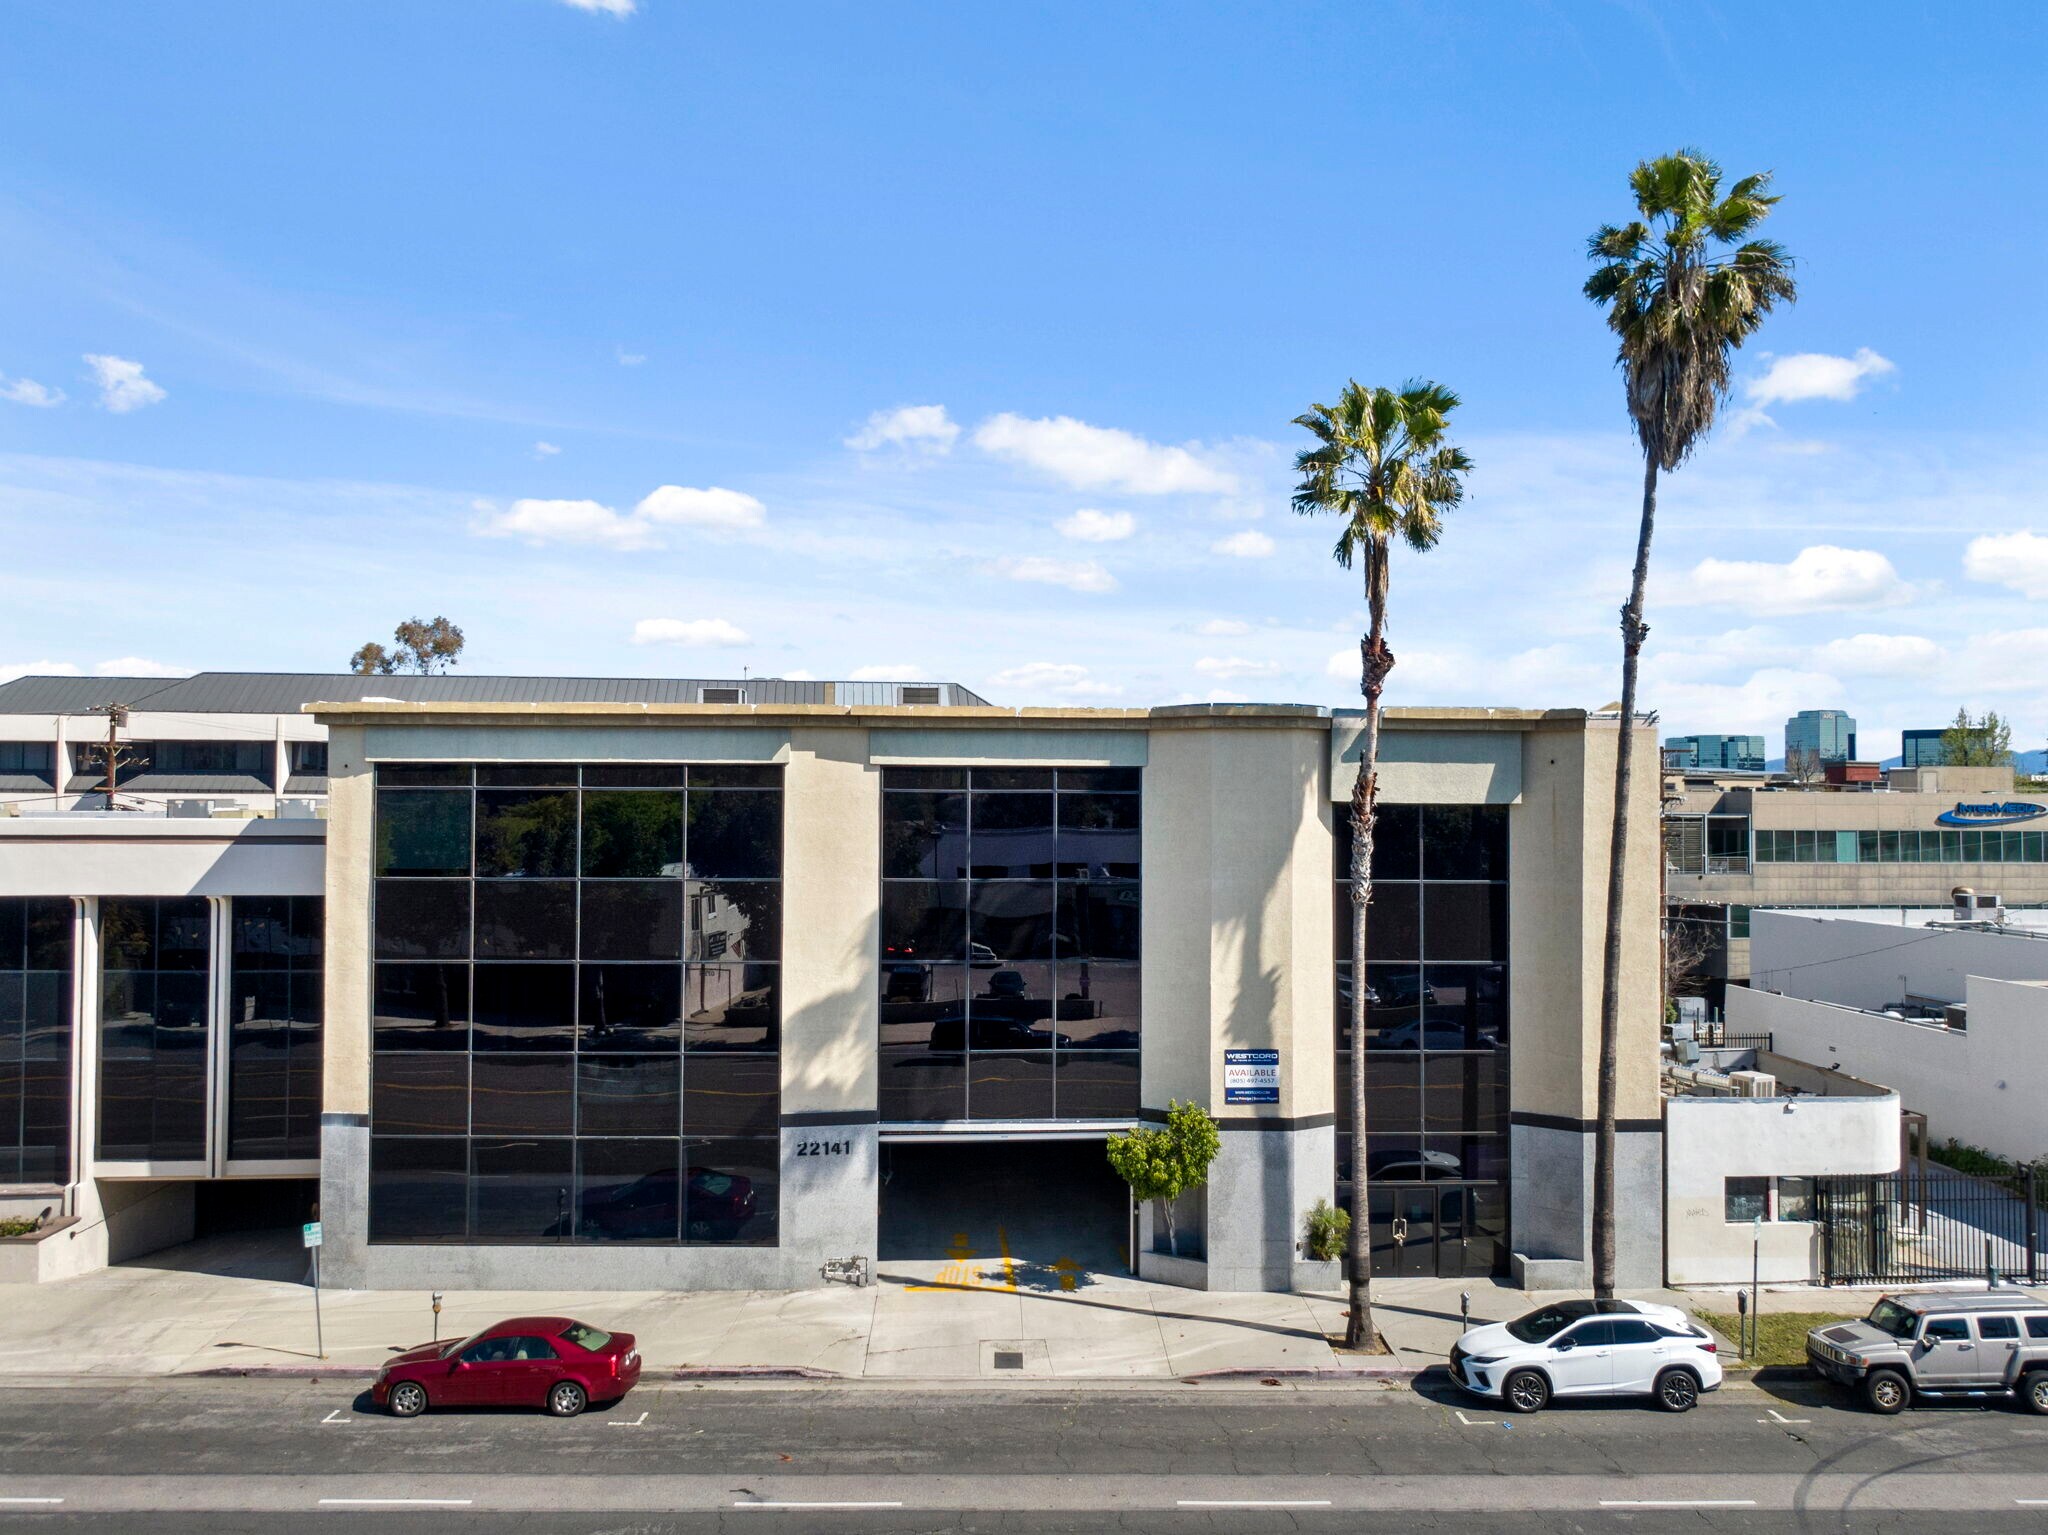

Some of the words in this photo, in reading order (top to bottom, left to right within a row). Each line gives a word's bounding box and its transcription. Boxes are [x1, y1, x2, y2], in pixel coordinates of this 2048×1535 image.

[1229, 1069, 1276, 1077] AVAILABLE
[797, 1141, 850, 1156] 22141
[935, 1265, 984, 1286] STOP
